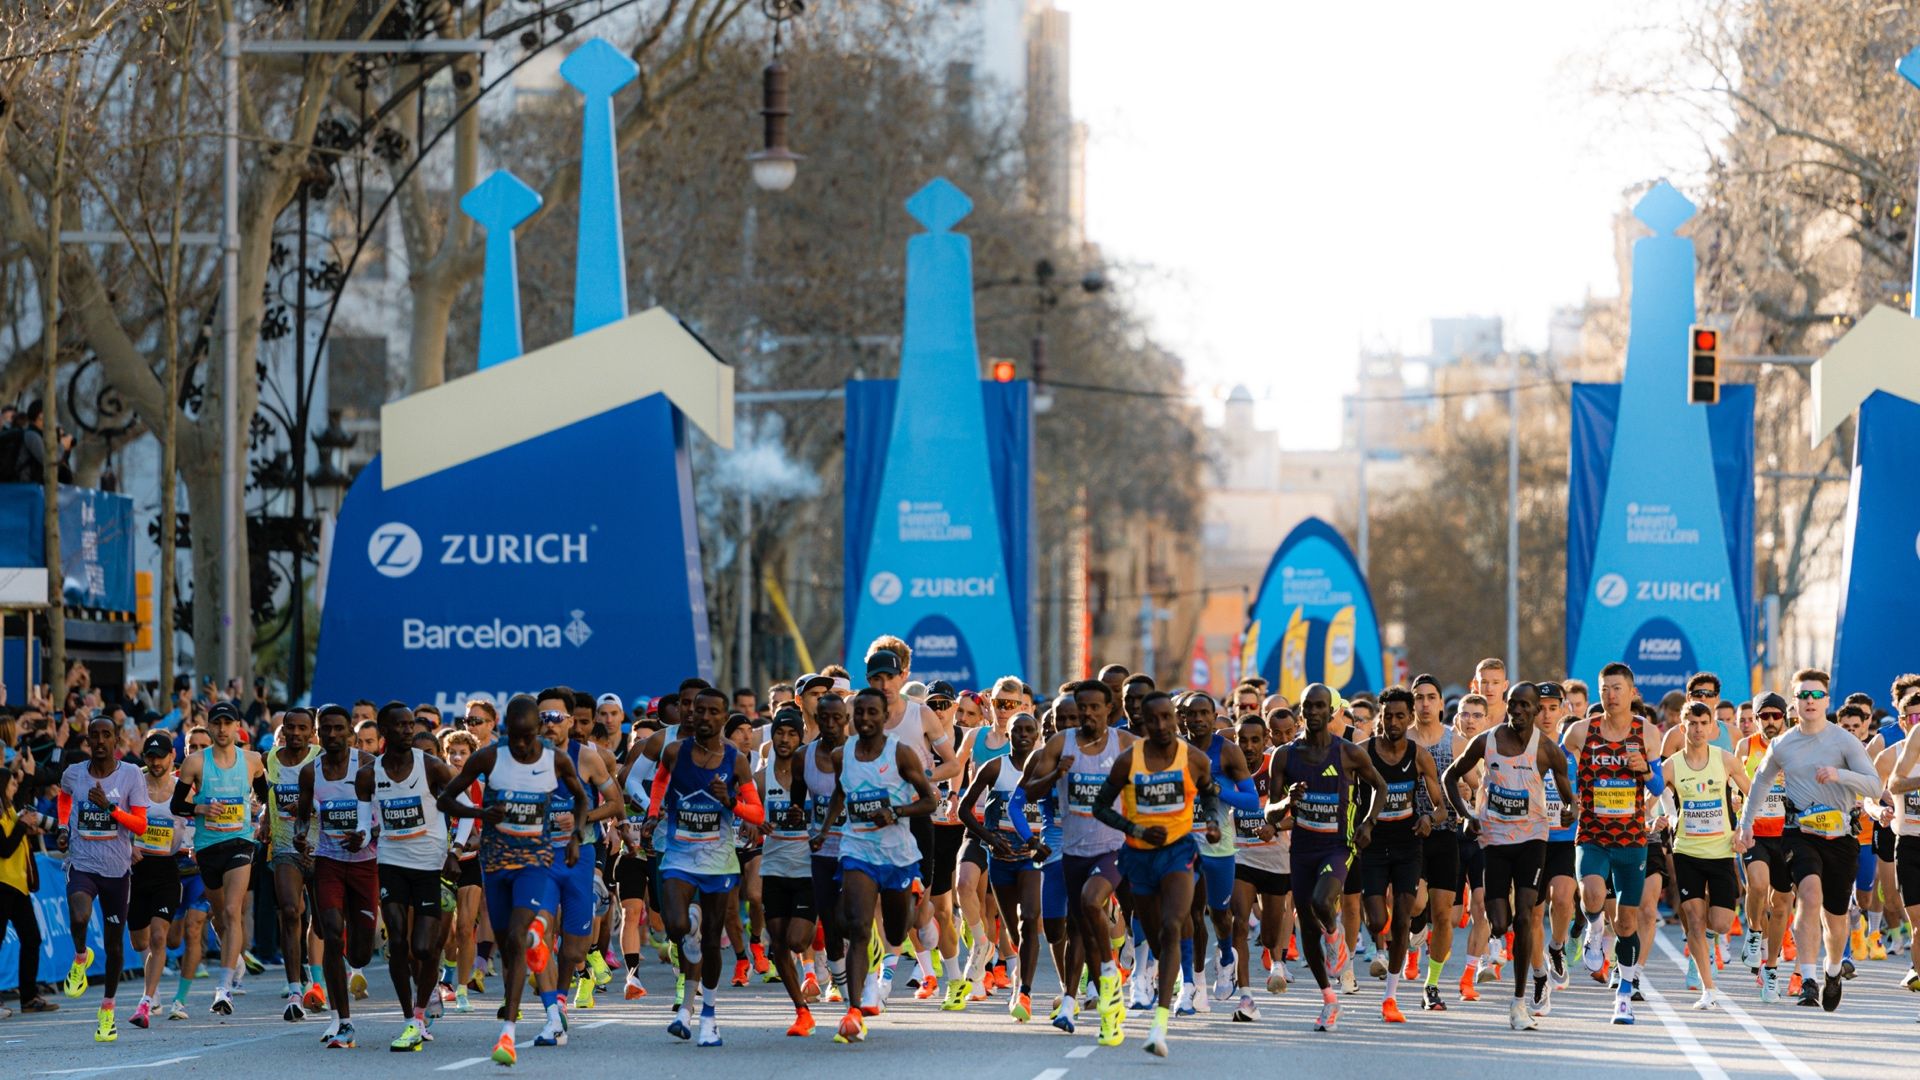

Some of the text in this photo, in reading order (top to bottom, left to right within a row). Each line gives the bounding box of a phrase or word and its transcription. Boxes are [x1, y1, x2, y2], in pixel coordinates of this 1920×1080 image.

[440, 534, 588, 564] ZURICH
[911, 577, 995, 597] ZURICH
[1637, 580, 1720, 601] ZURICH
[403, 618, 561, 649] Barcelona
[1591, 756, 1629, 765] KENY
[1075, 785, 1101, 794] PACE
[1144, 783, 1175, 795] PACER
[279, 793, 300, 802] PACE
[1491, 794, 1525, 808] KIPKECH
[506, 802, 537, 814] PACER
[854, 801, 882, 813] PACER
[1296, 801, 1339, 812] CHELANGAT
[328, 810, 357, 820] GEBRE
[384, 807, 418, 819] ÖZBILEN
[679, 811, 719, 823] YITAYEW
[1683, 809, 1723, 818] FRANCESCO
[1240, 819, 1266, 828] ABERA
[146, 829, 171, 838] MIDZE
